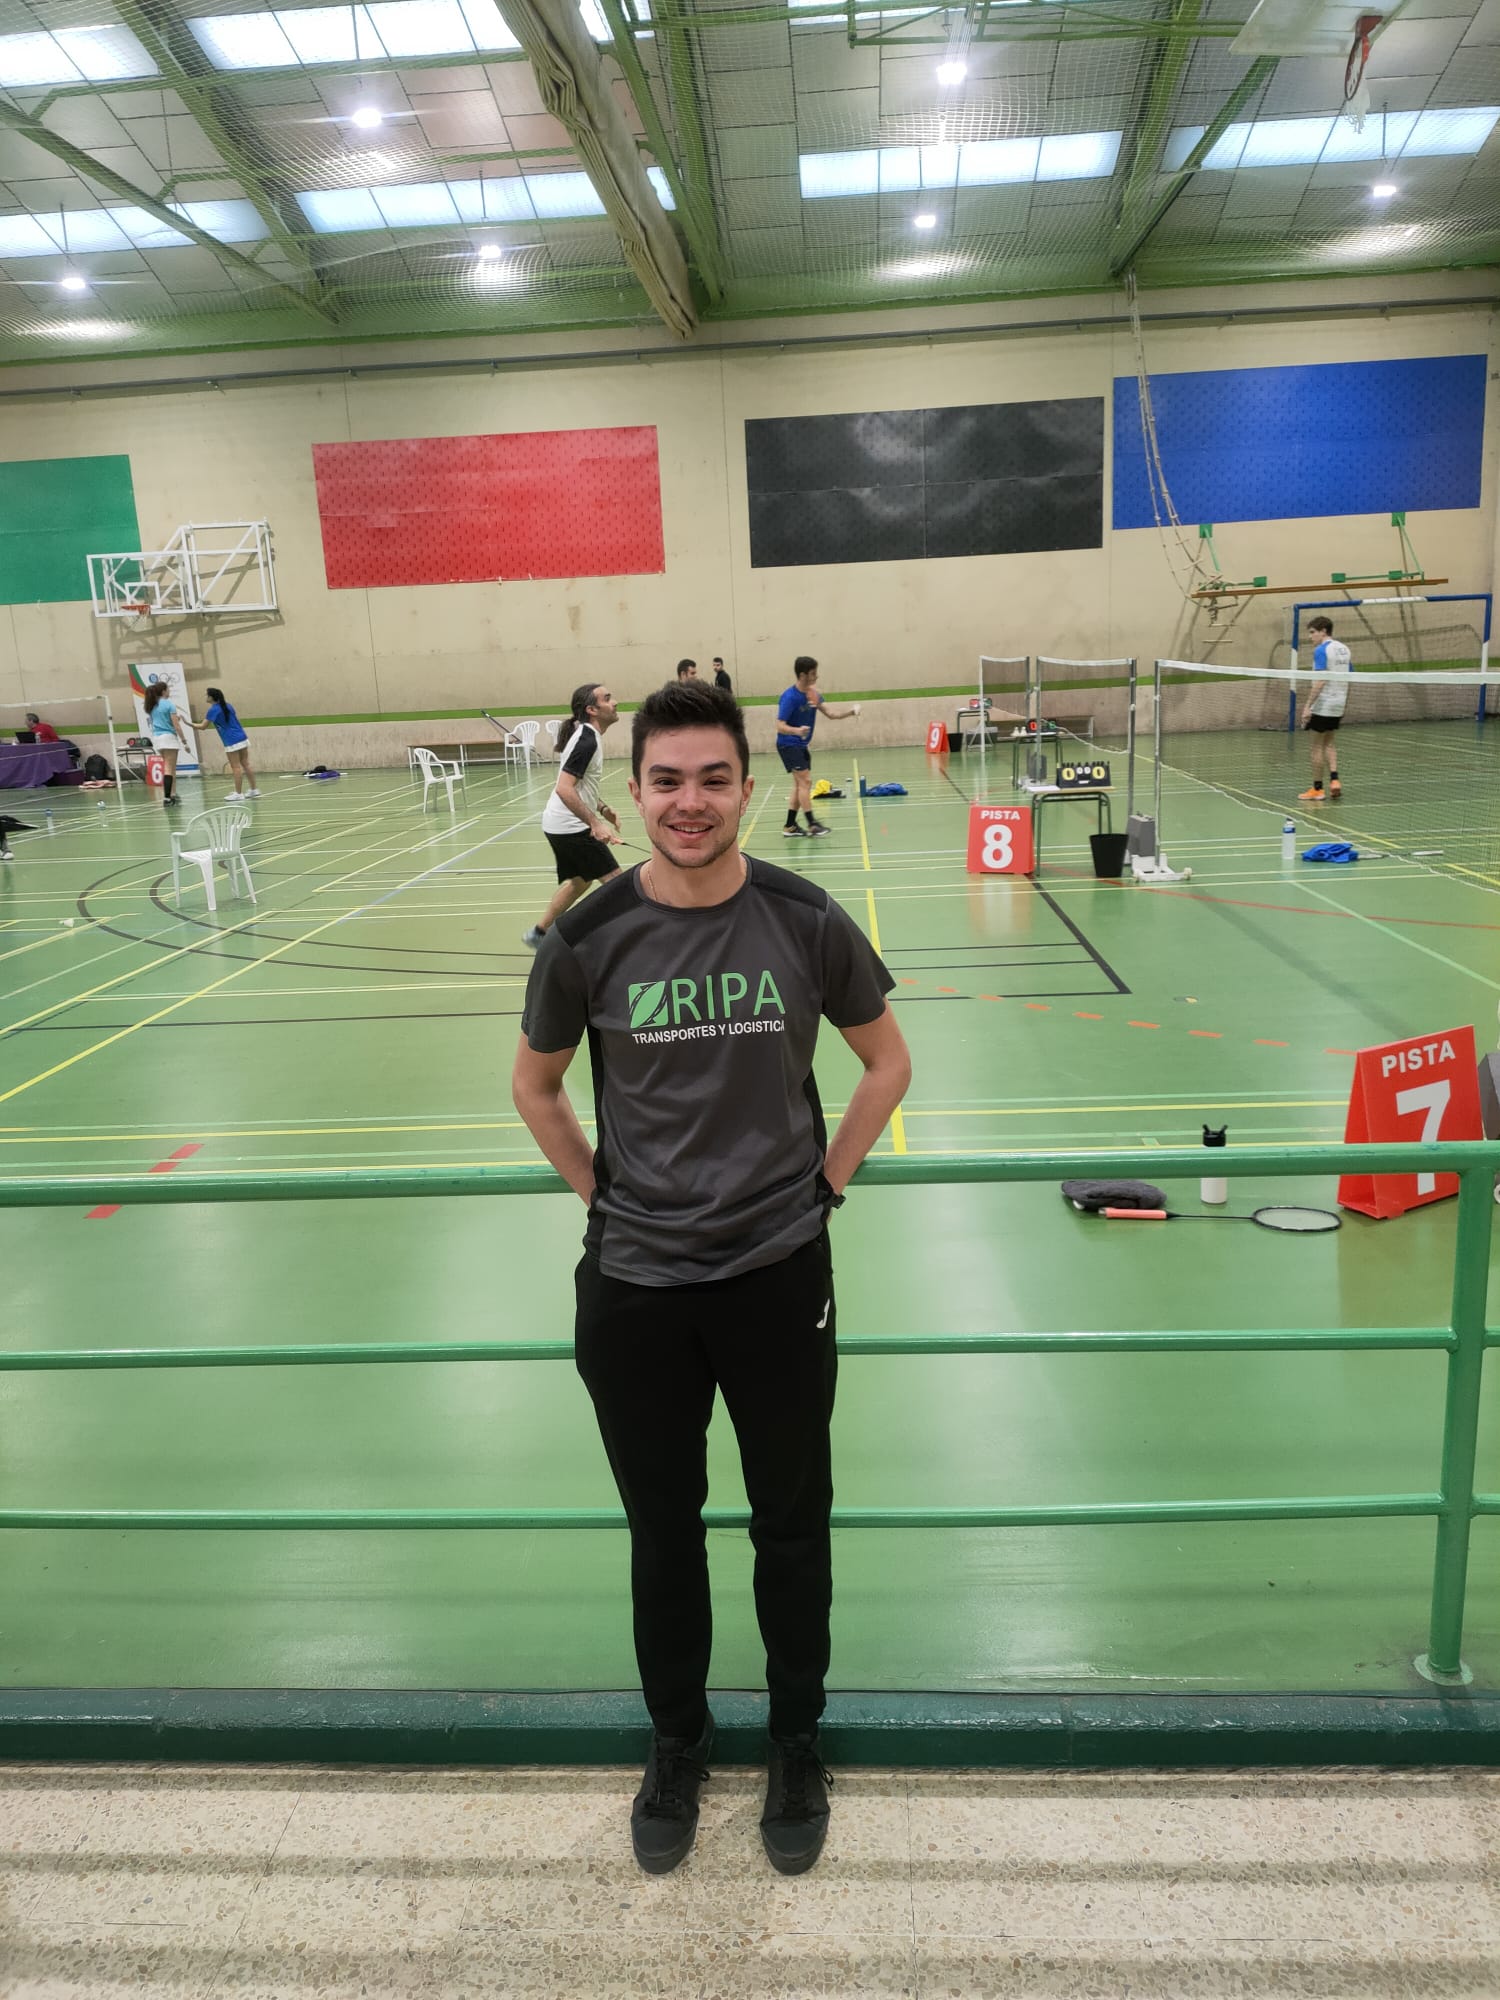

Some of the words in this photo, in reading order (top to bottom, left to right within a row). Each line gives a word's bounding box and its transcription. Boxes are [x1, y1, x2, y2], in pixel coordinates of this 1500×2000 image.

[929, 727, 940, 749] 9
[152, 763, 163, 784] 6
[981, 809, 1021, 821] PISTA
[982, 824, 1013, 869] 8
[671, 969, 786, 1025] RIPA
[632, 1024, 717, 1044] TRANSPORTES
[718, 1024, 727, 1036] Y
[1381, 1040, 1456, 1078] PISTA
[1396, 1079, 1451, 1196] 7
